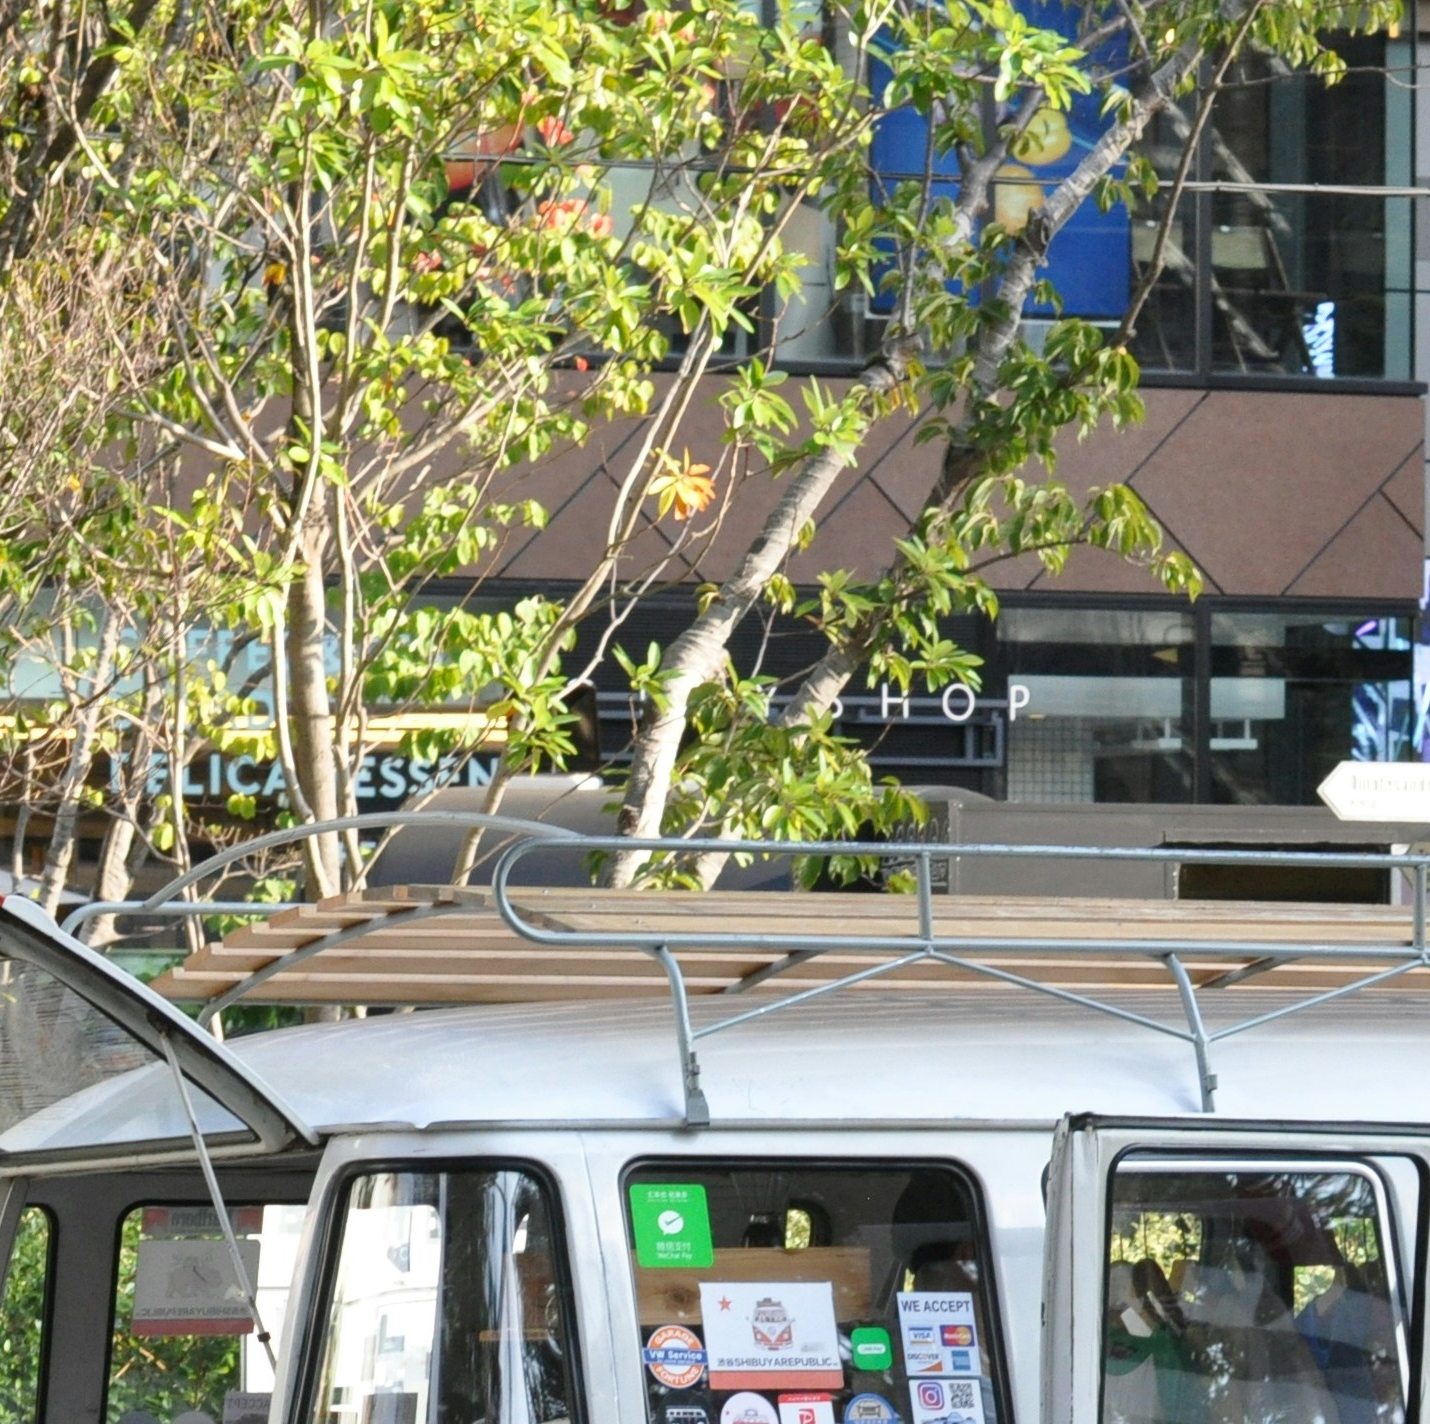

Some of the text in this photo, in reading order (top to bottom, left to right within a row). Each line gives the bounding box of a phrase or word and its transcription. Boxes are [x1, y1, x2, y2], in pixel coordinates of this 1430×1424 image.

[901, 1300, 971, 1312] WE ACCEPT
[655, 1328, 696, 1345] GARAGE
[649, 1350, 703, 1360] VW Service
[655, 1366, 699, 1385] FORTUNE
